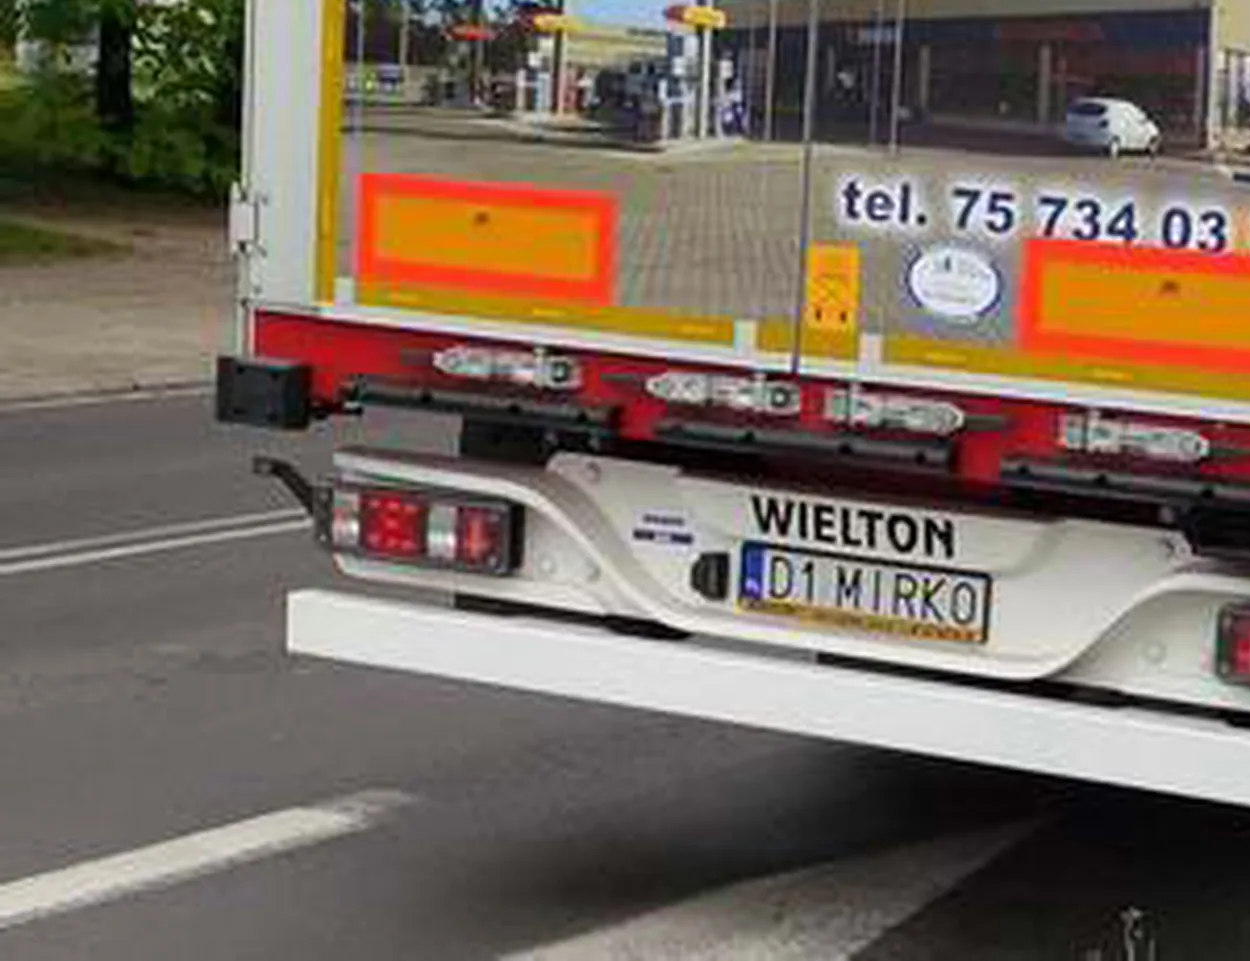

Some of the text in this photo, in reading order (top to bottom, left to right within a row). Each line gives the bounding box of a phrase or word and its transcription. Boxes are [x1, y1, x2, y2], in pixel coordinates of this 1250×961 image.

[842, 179, 928, 226] tel.
[952, 187, 1016, 233] 75
[1037, 195, 1139, 242] 734
[1161, 205, 1227, 250] 03
[751, 494, 956, 559] WIELTON
[768, 554, 815, 604] D1
[835, 566, 978, 627] MIRKO
